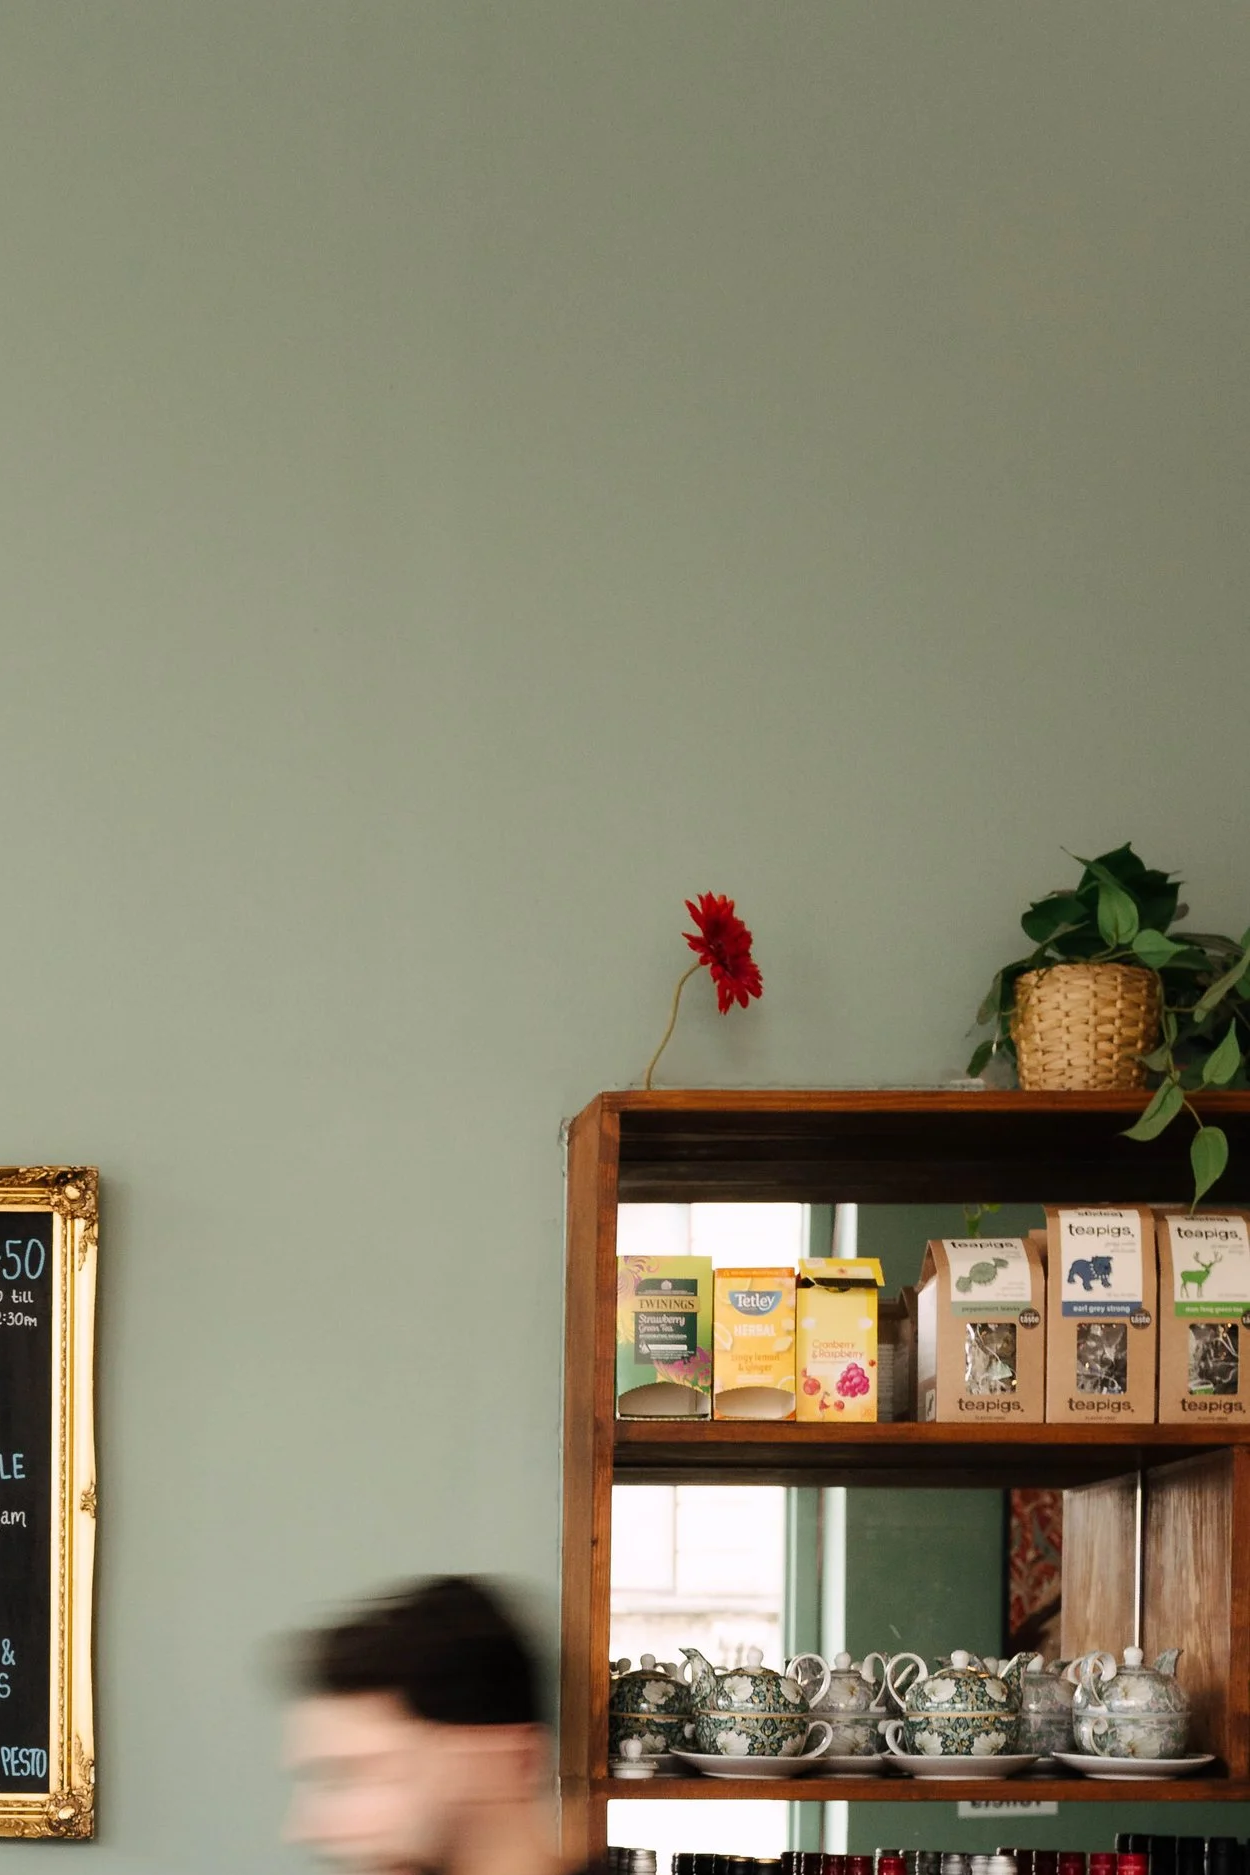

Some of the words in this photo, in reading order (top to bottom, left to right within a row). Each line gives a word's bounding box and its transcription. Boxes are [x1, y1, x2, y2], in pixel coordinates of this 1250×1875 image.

[12, 1289, 34, 1303] till
[735, 1293, 775, 1311] Tetley
[639, 1299, 695, 1310] TWININGS
[1073, 1305, 1088, 1313] earl
[1089, 1305, 1105, 1315] grey
[1106, 1305, 1131, 1315] strong
[638, 1314, 686, 1327] Strawberry
[1, 1638, 16, 1667] &
[1, 1749, 47, 1778] PESTO
